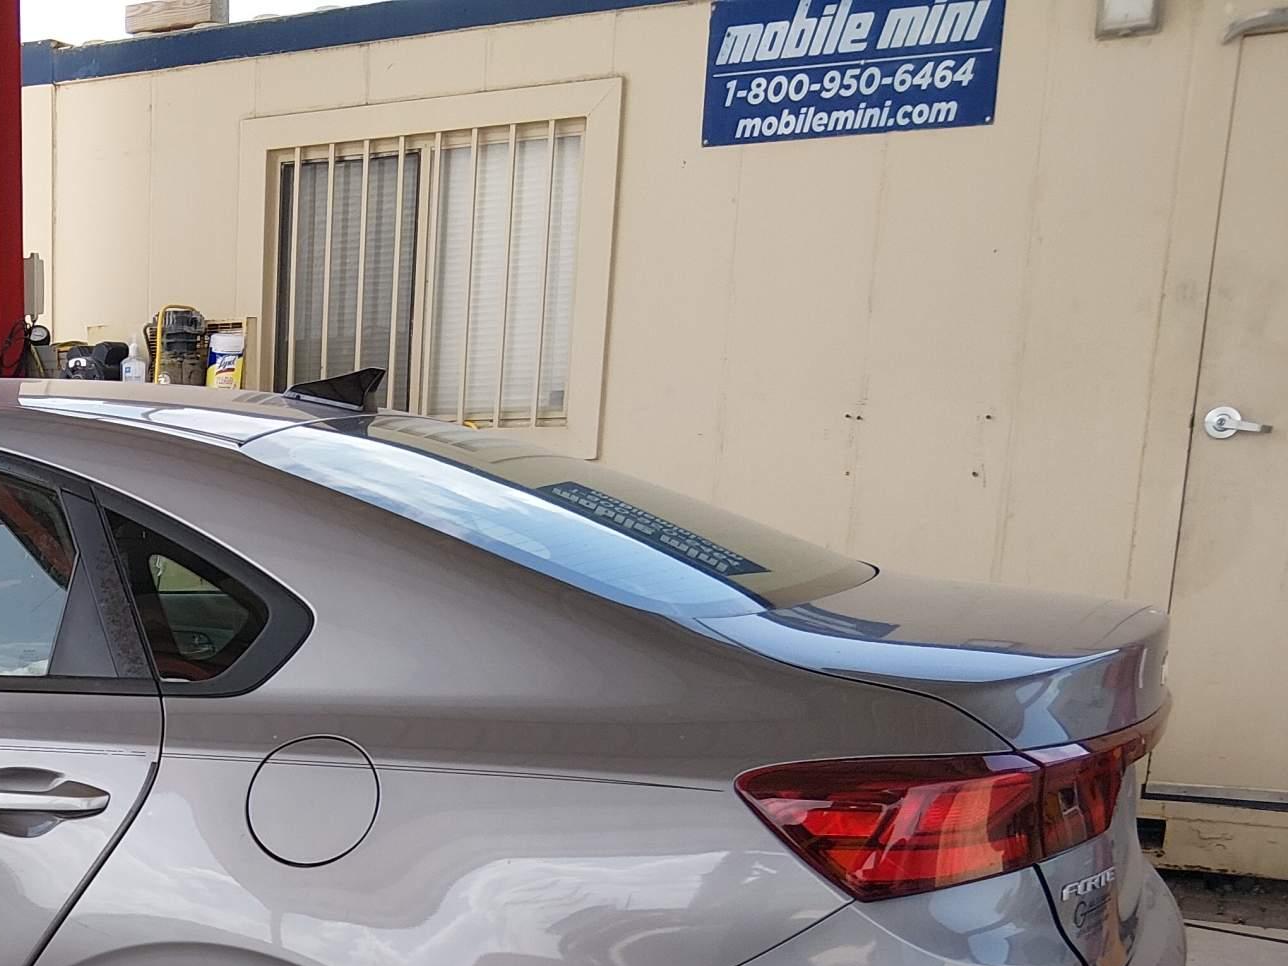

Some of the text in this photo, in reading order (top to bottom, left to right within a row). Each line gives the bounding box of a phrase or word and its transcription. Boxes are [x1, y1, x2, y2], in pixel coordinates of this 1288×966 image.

[715, 0, 989, 65] mobile mini
[724, 57, 977, 107] 1-800-950-6464
[735, 100, 958, 138] mobilemini.com
[1061, 866, 1116, 901] FORTE
